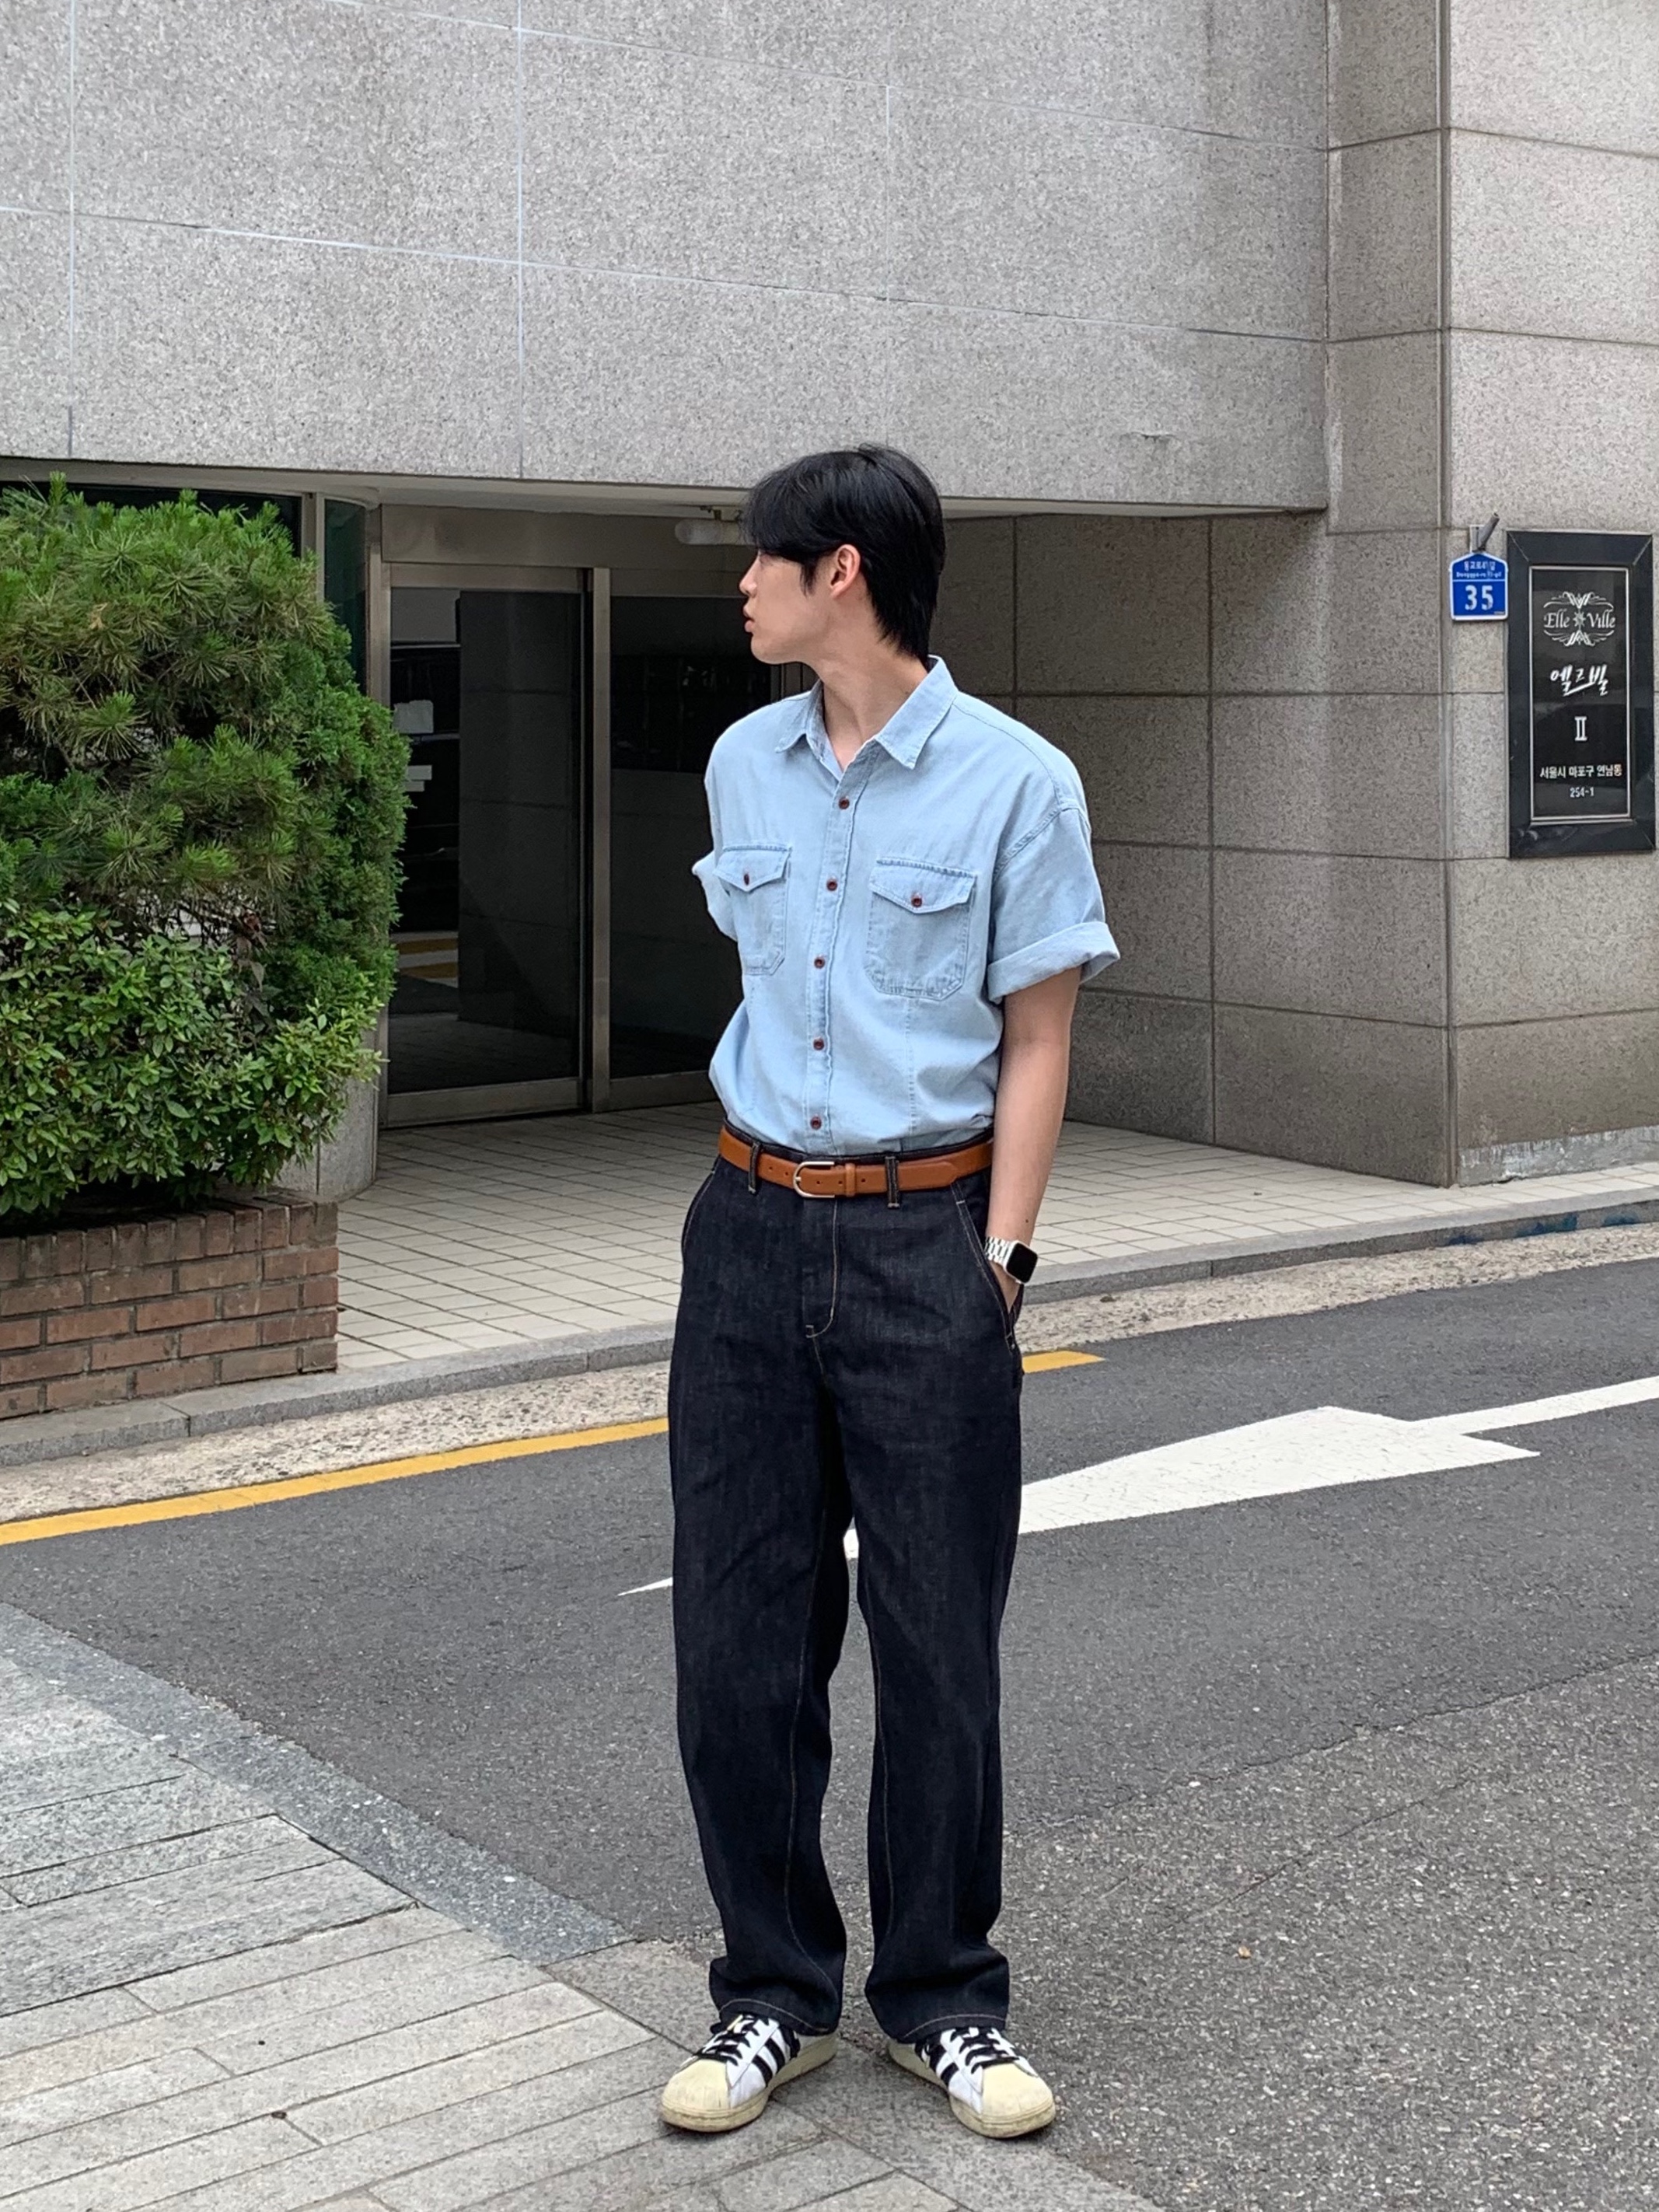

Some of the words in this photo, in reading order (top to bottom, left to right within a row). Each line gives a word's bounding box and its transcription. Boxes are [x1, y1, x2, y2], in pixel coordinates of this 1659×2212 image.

[1465, 585, 1493, 610] 35
[1544, 609, 1570, 628] Elle
[1586, 610, 1616, 628] Ville
[1539, 766, 1566, 779] 서울시
[1568, 765, 1594, 778] 마포구
[1596, 764, 1622, 777] 연남동
[1570, 787, 1594, 798] 254-1
